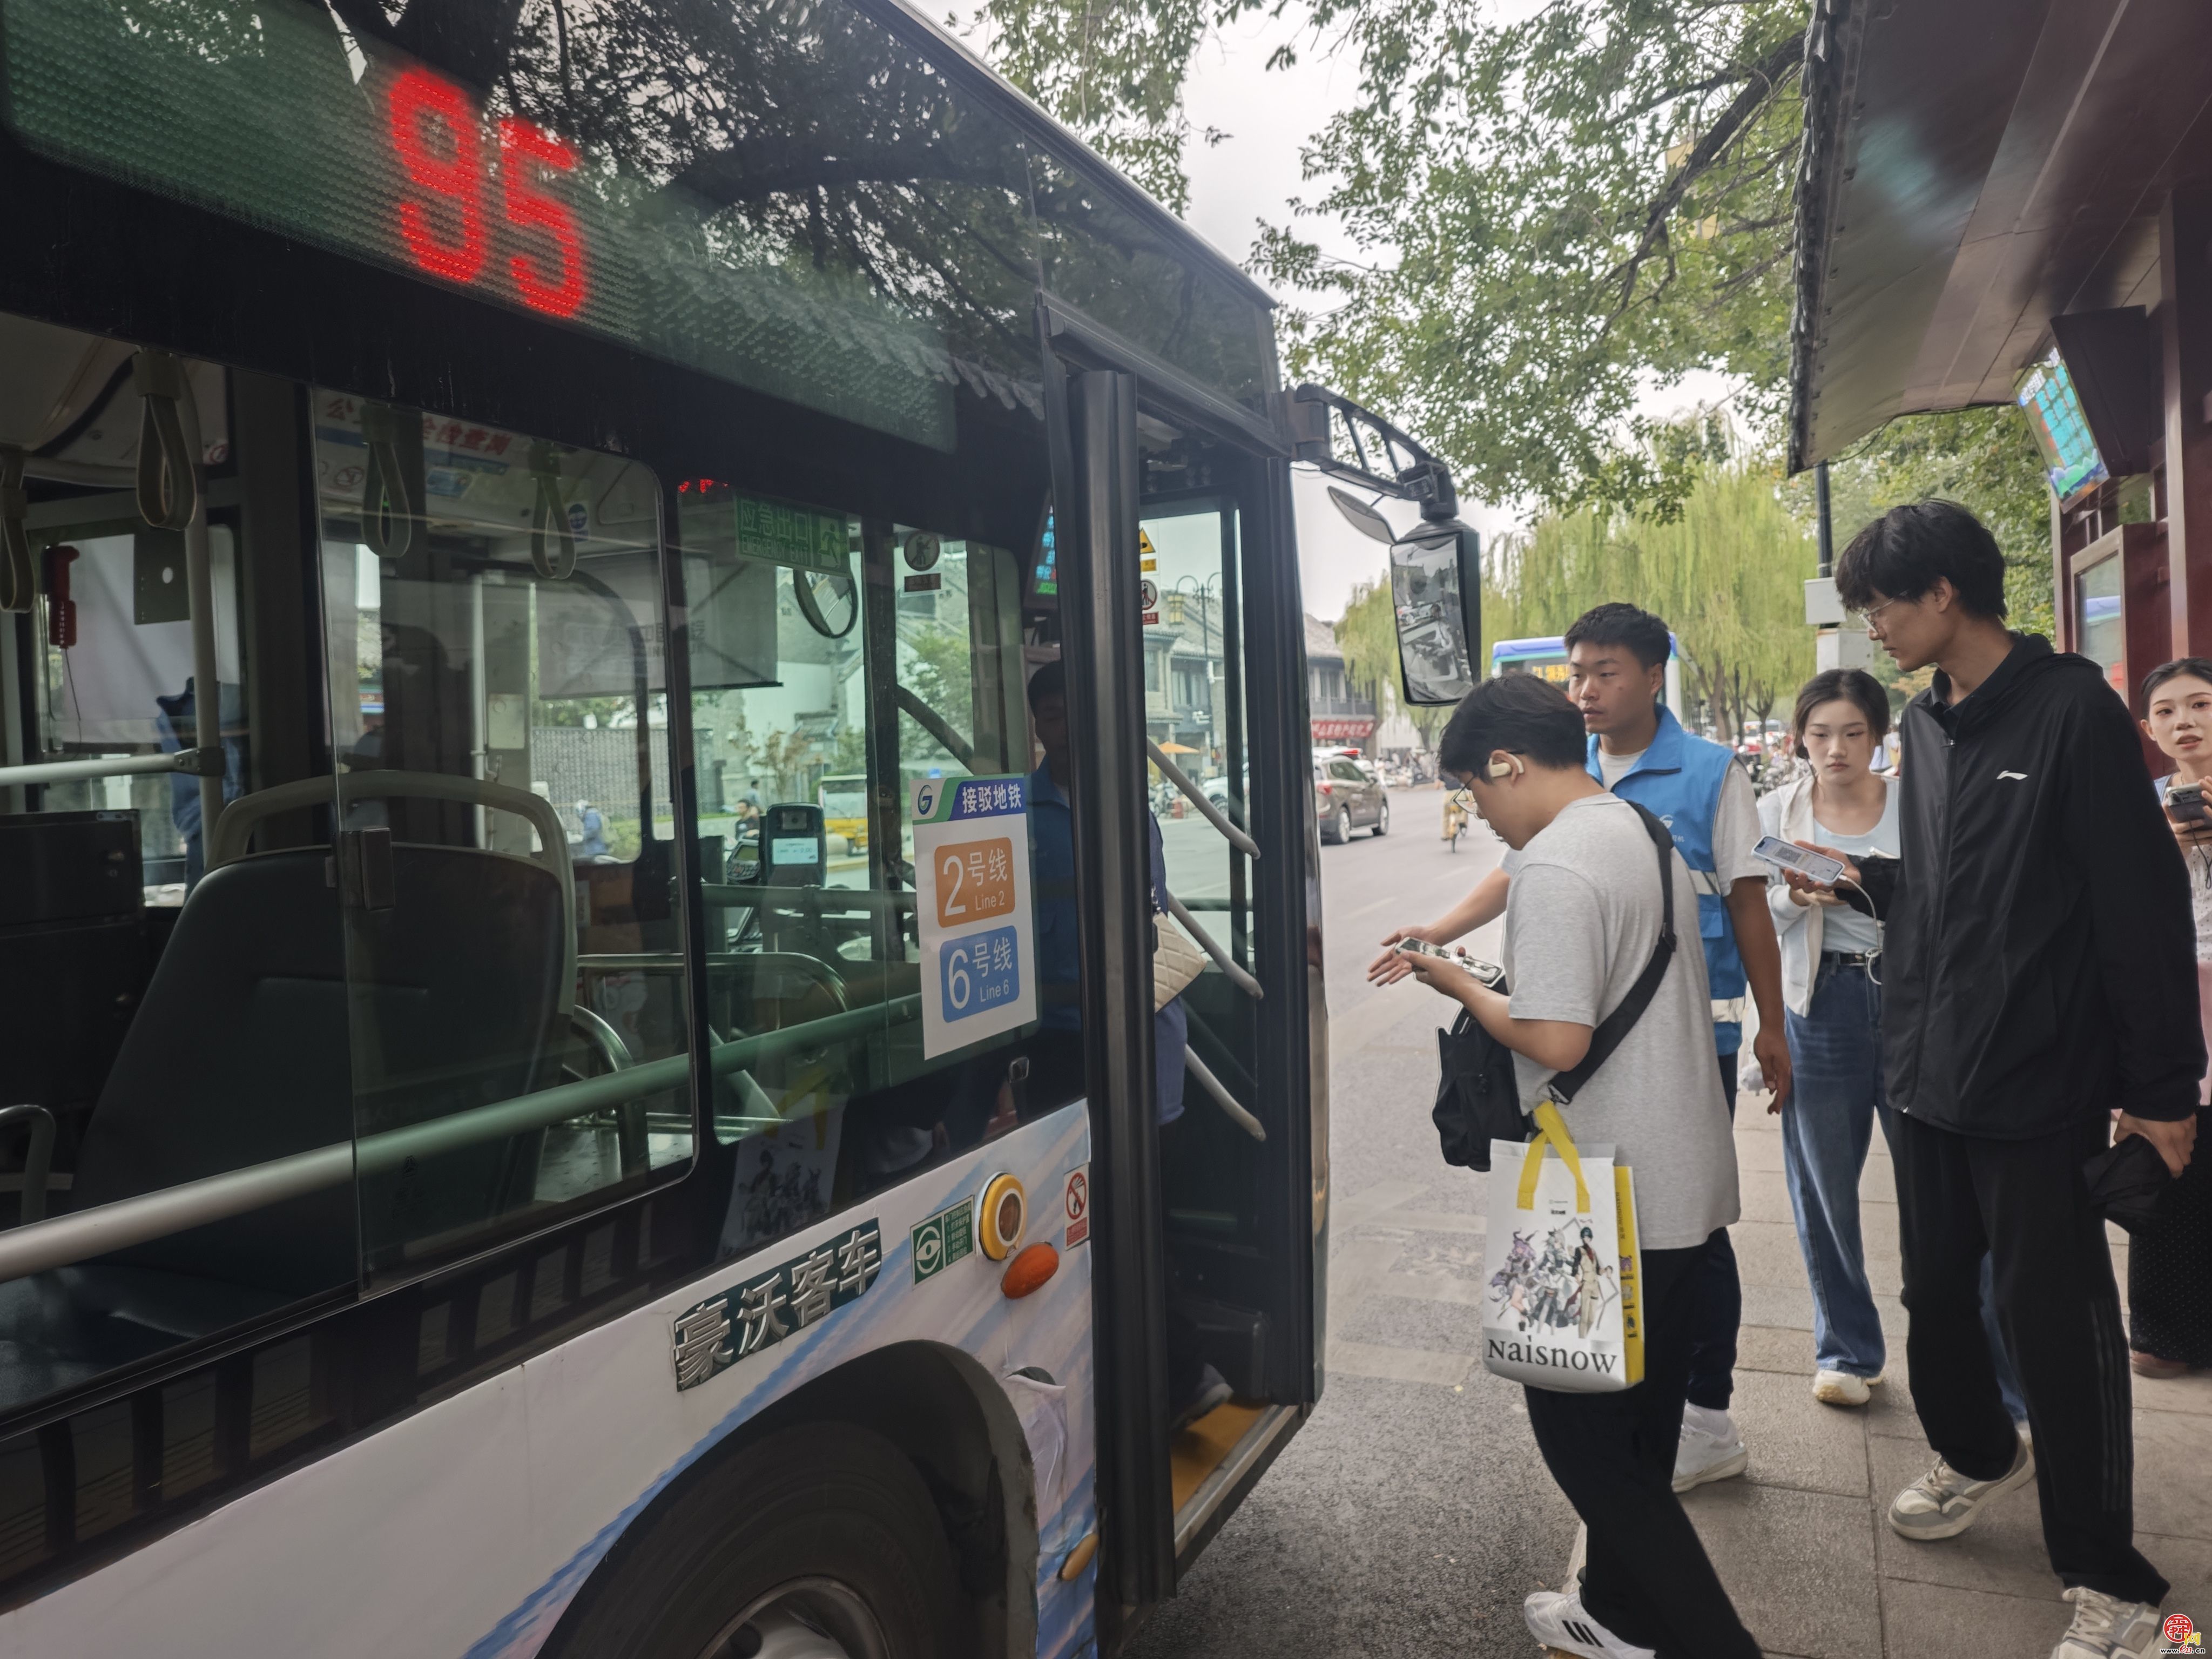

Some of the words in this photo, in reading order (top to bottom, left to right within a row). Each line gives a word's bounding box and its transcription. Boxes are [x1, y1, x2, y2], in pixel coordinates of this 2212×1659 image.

[390, 66, 585, 318] 95
[740, 498, 808, 543] 应急出口
[741, 535, 786, 557] EMERGENCY
[789, 543, 808, 564] EXIT
[962, 783, 1022, 814] 接驳地铁
[942, 847, 1008, 917] 2号线
[975, 893, 997, 911] Line
[999, 890, 1005, 906] 2
[948, 938, 1012, 1010] 6号线
[979, 981, 1002, 1003] Line
[1003, 979, 1010, 995] 6
[676, 1229, 881, 1390] 豪沃客车
